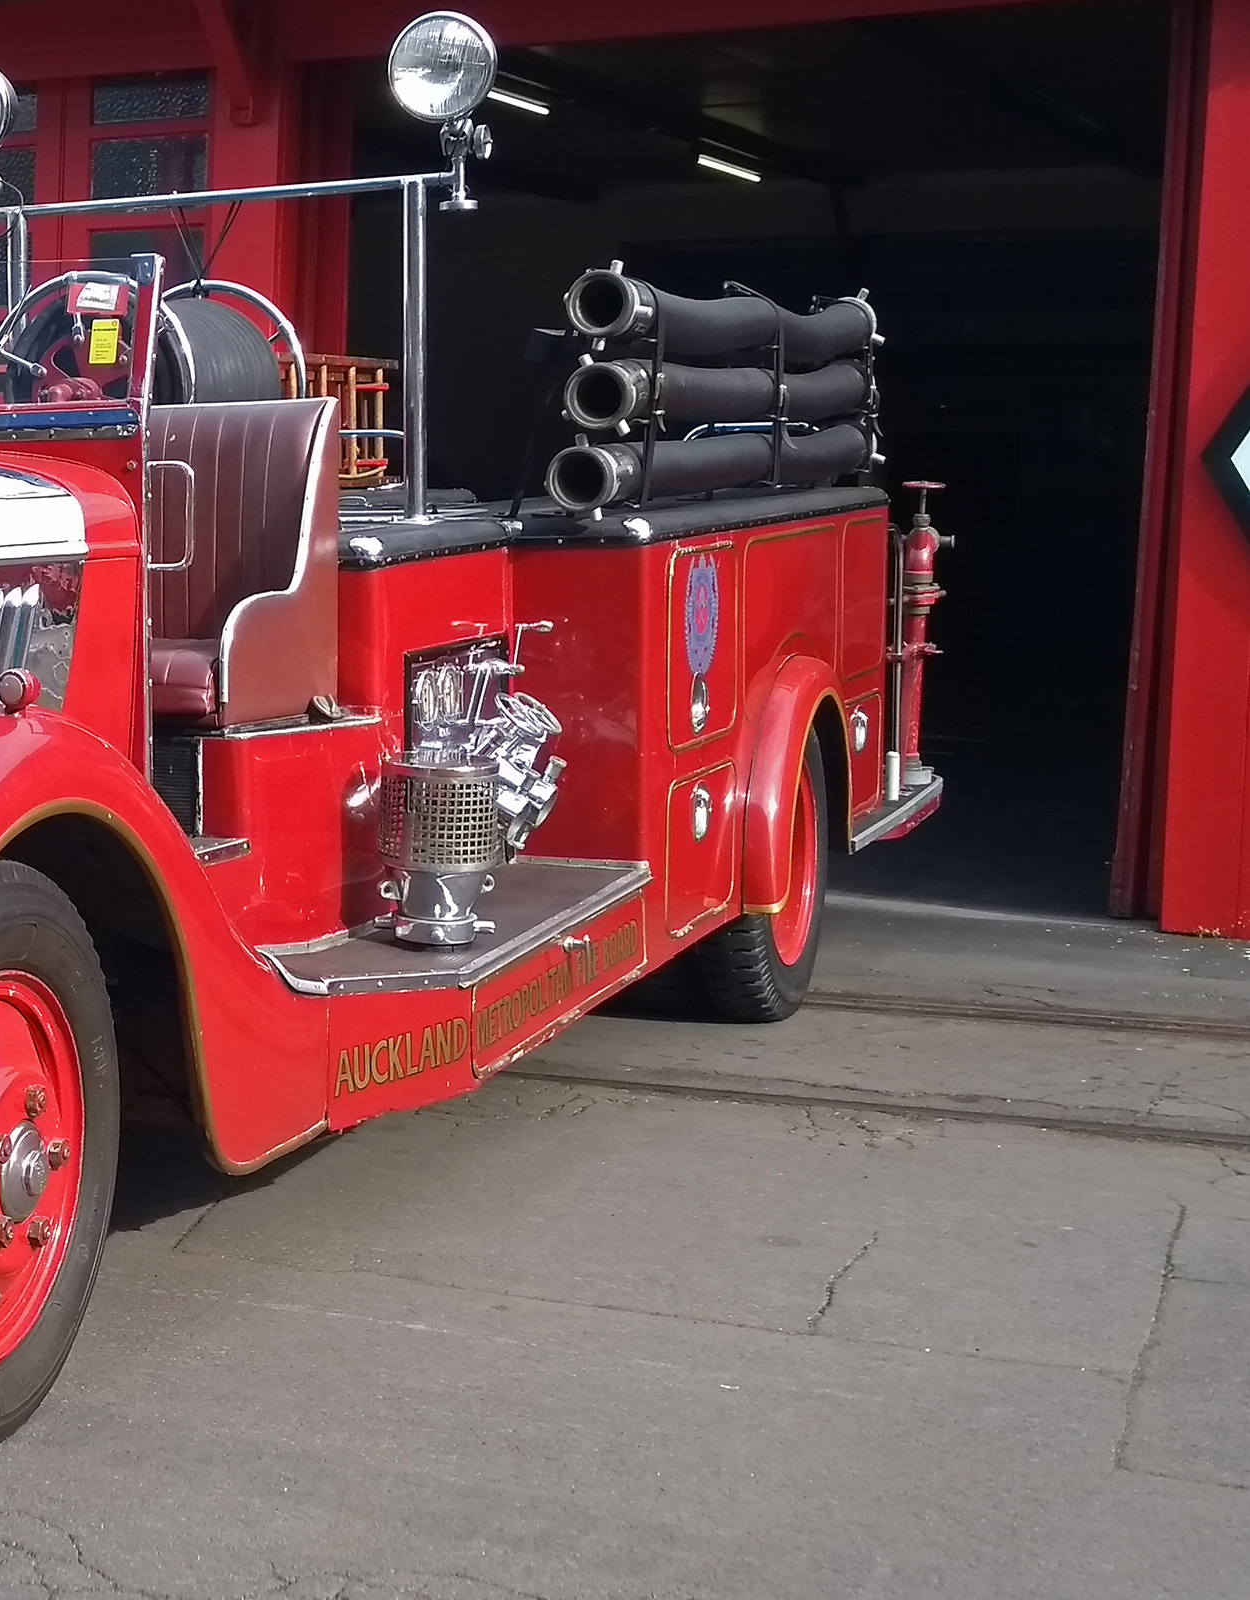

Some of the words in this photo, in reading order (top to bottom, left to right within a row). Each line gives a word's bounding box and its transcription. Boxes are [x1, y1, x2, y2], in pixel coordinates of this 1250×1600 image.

[335, 1018, 467, 1097] AUCKLAND
[476, 960, 573, 1051] METROPOLITAN
[602, 919, 638, 972] BOARD
